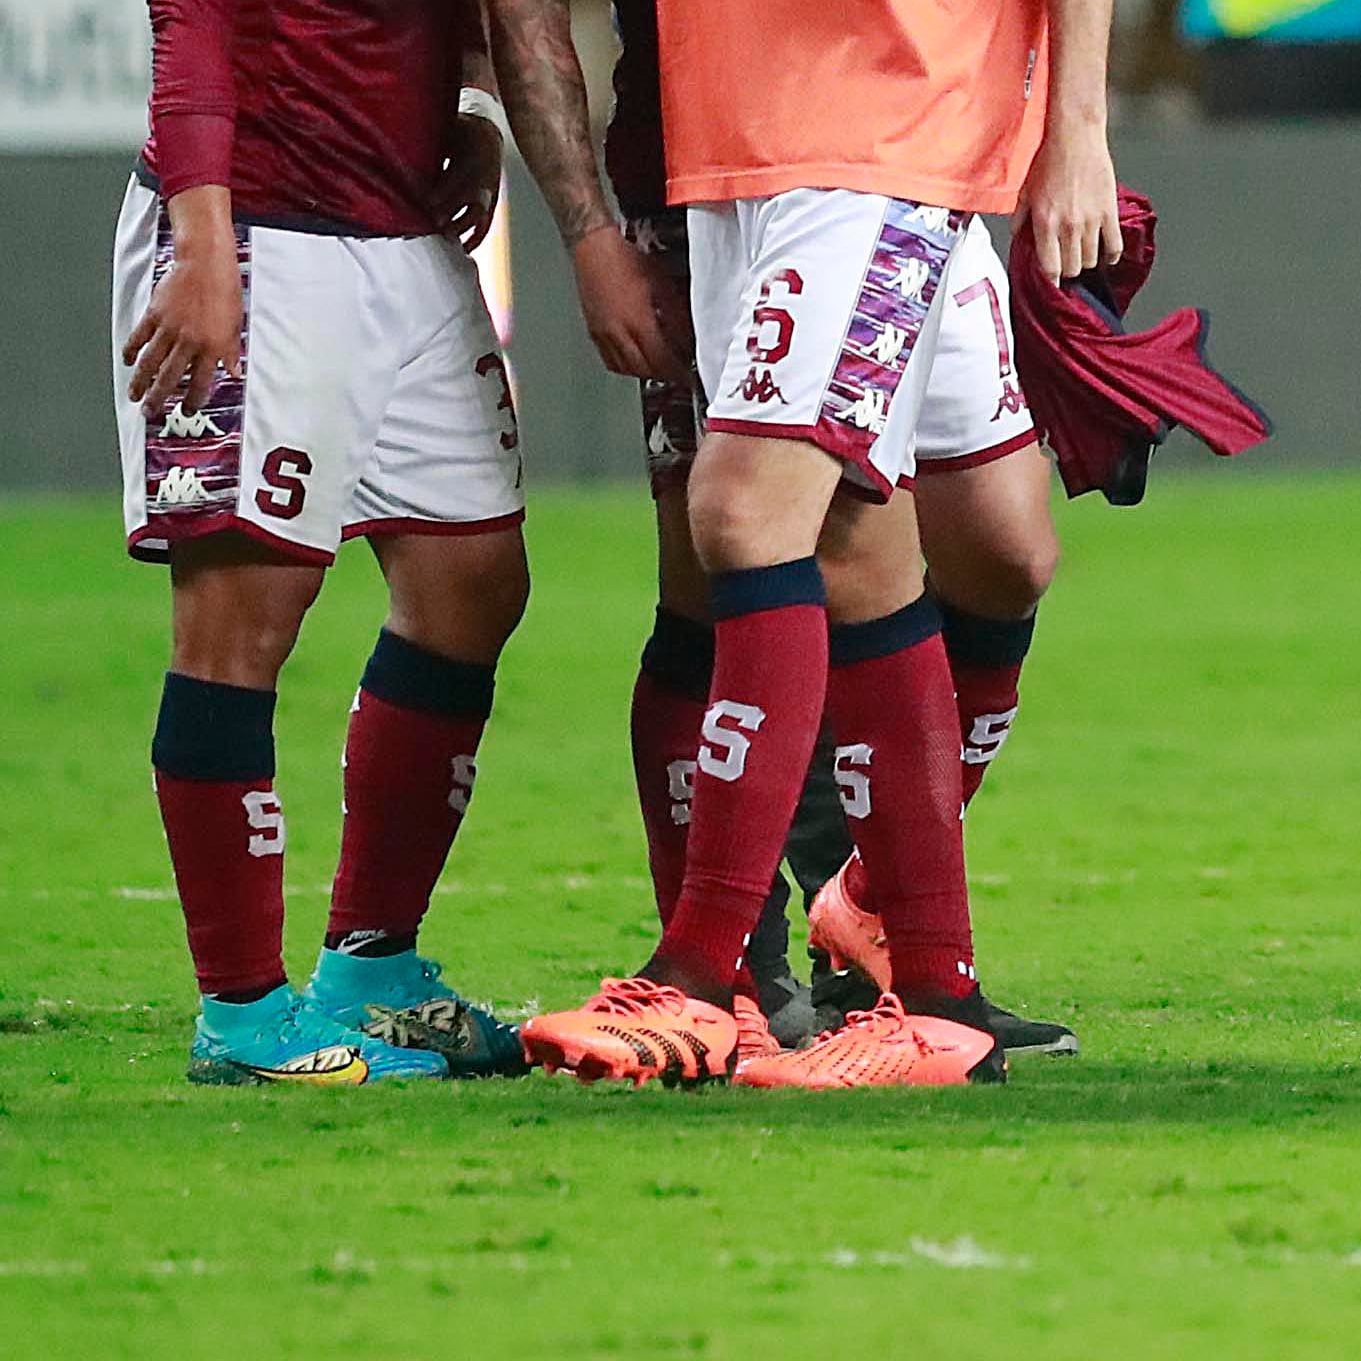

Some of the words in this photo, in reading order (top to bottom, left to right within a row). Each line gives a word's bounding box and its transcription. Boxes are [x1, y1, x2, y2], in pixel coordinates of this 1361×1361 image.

[746, 268, 804, 365] 6
[254, 446, 313, 520] S
[697, 699, 767, 782] S
[833, 742, 874, 820] S
